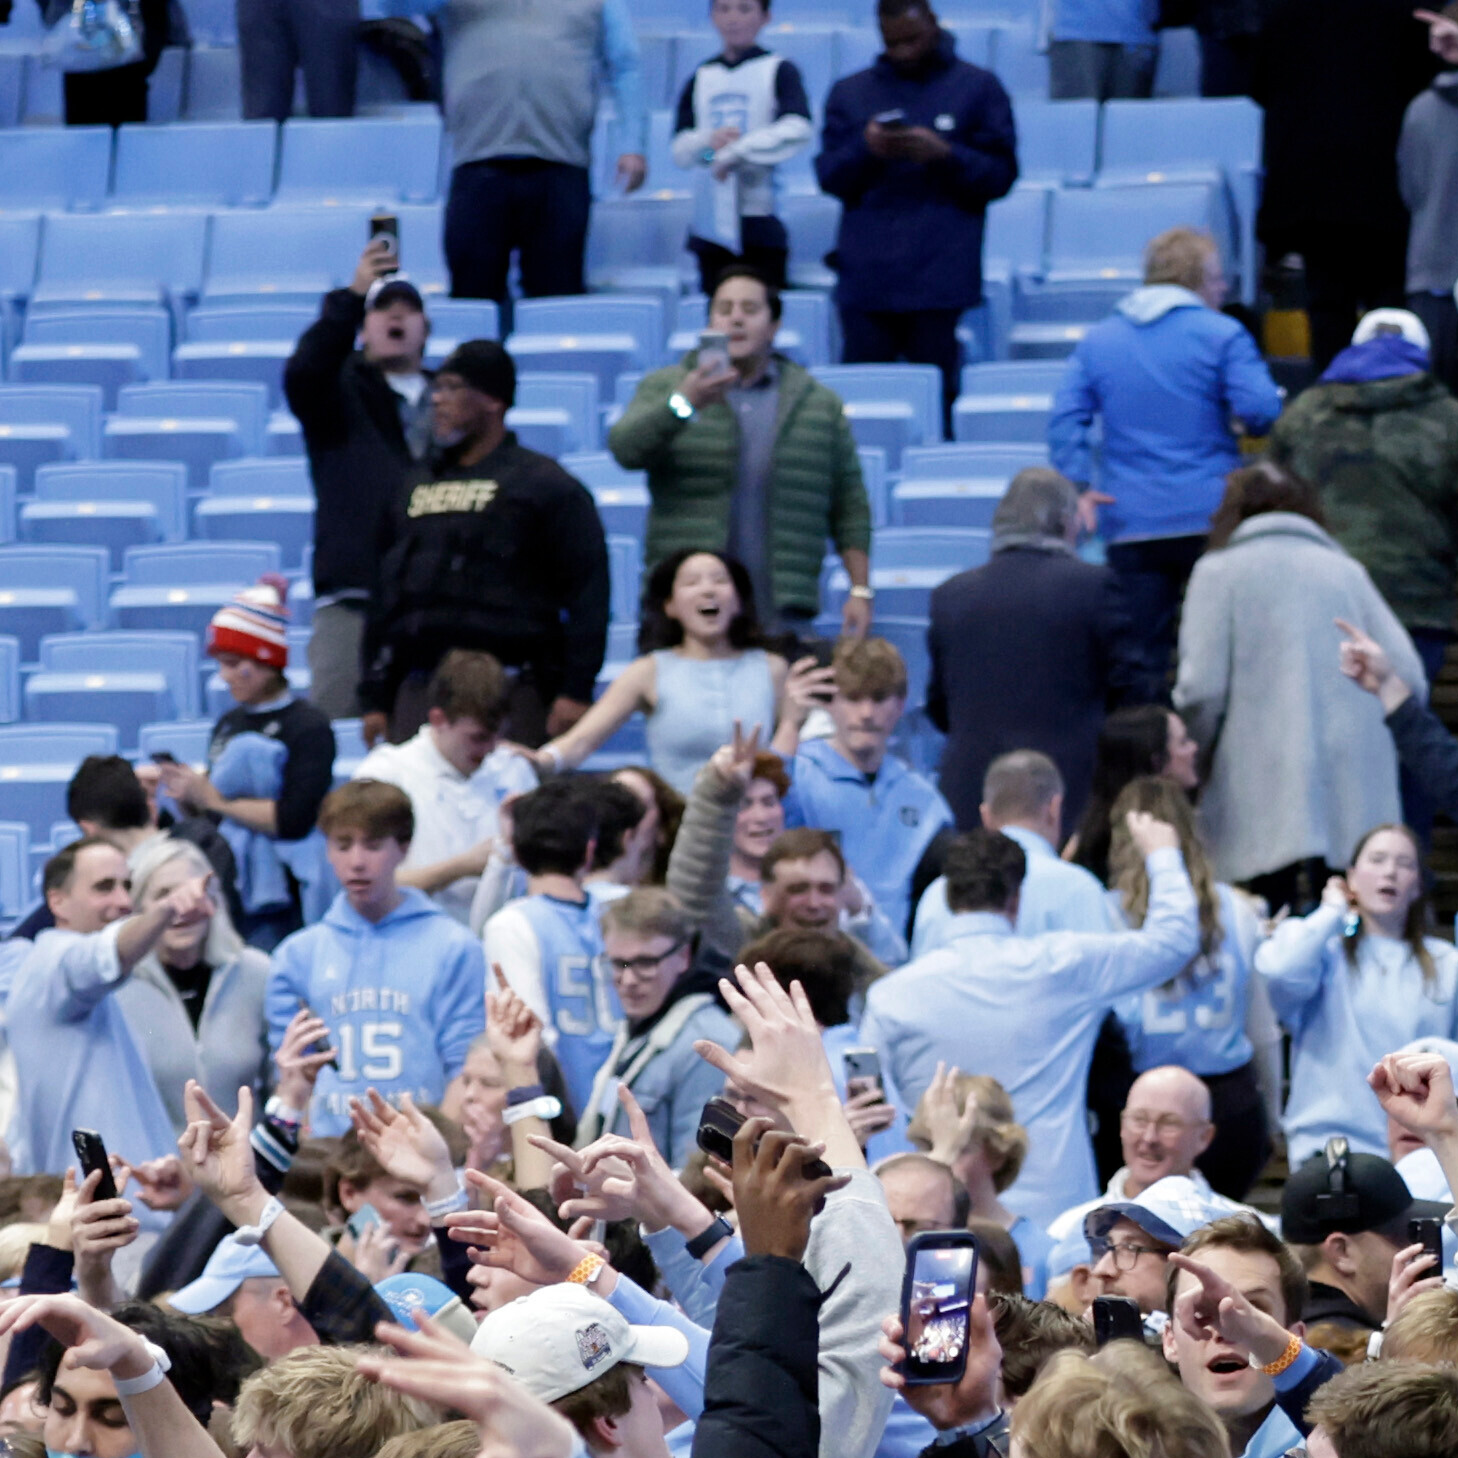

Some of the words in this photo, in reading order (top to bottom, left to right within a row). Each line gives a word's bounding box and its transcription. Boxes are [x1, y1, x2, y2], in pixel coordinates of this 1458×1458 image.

[407, 479, 498, 518] SHERIFF
[330, 988, 409, 1017] NORTH
[338, 1021, 402, 1082] 15
